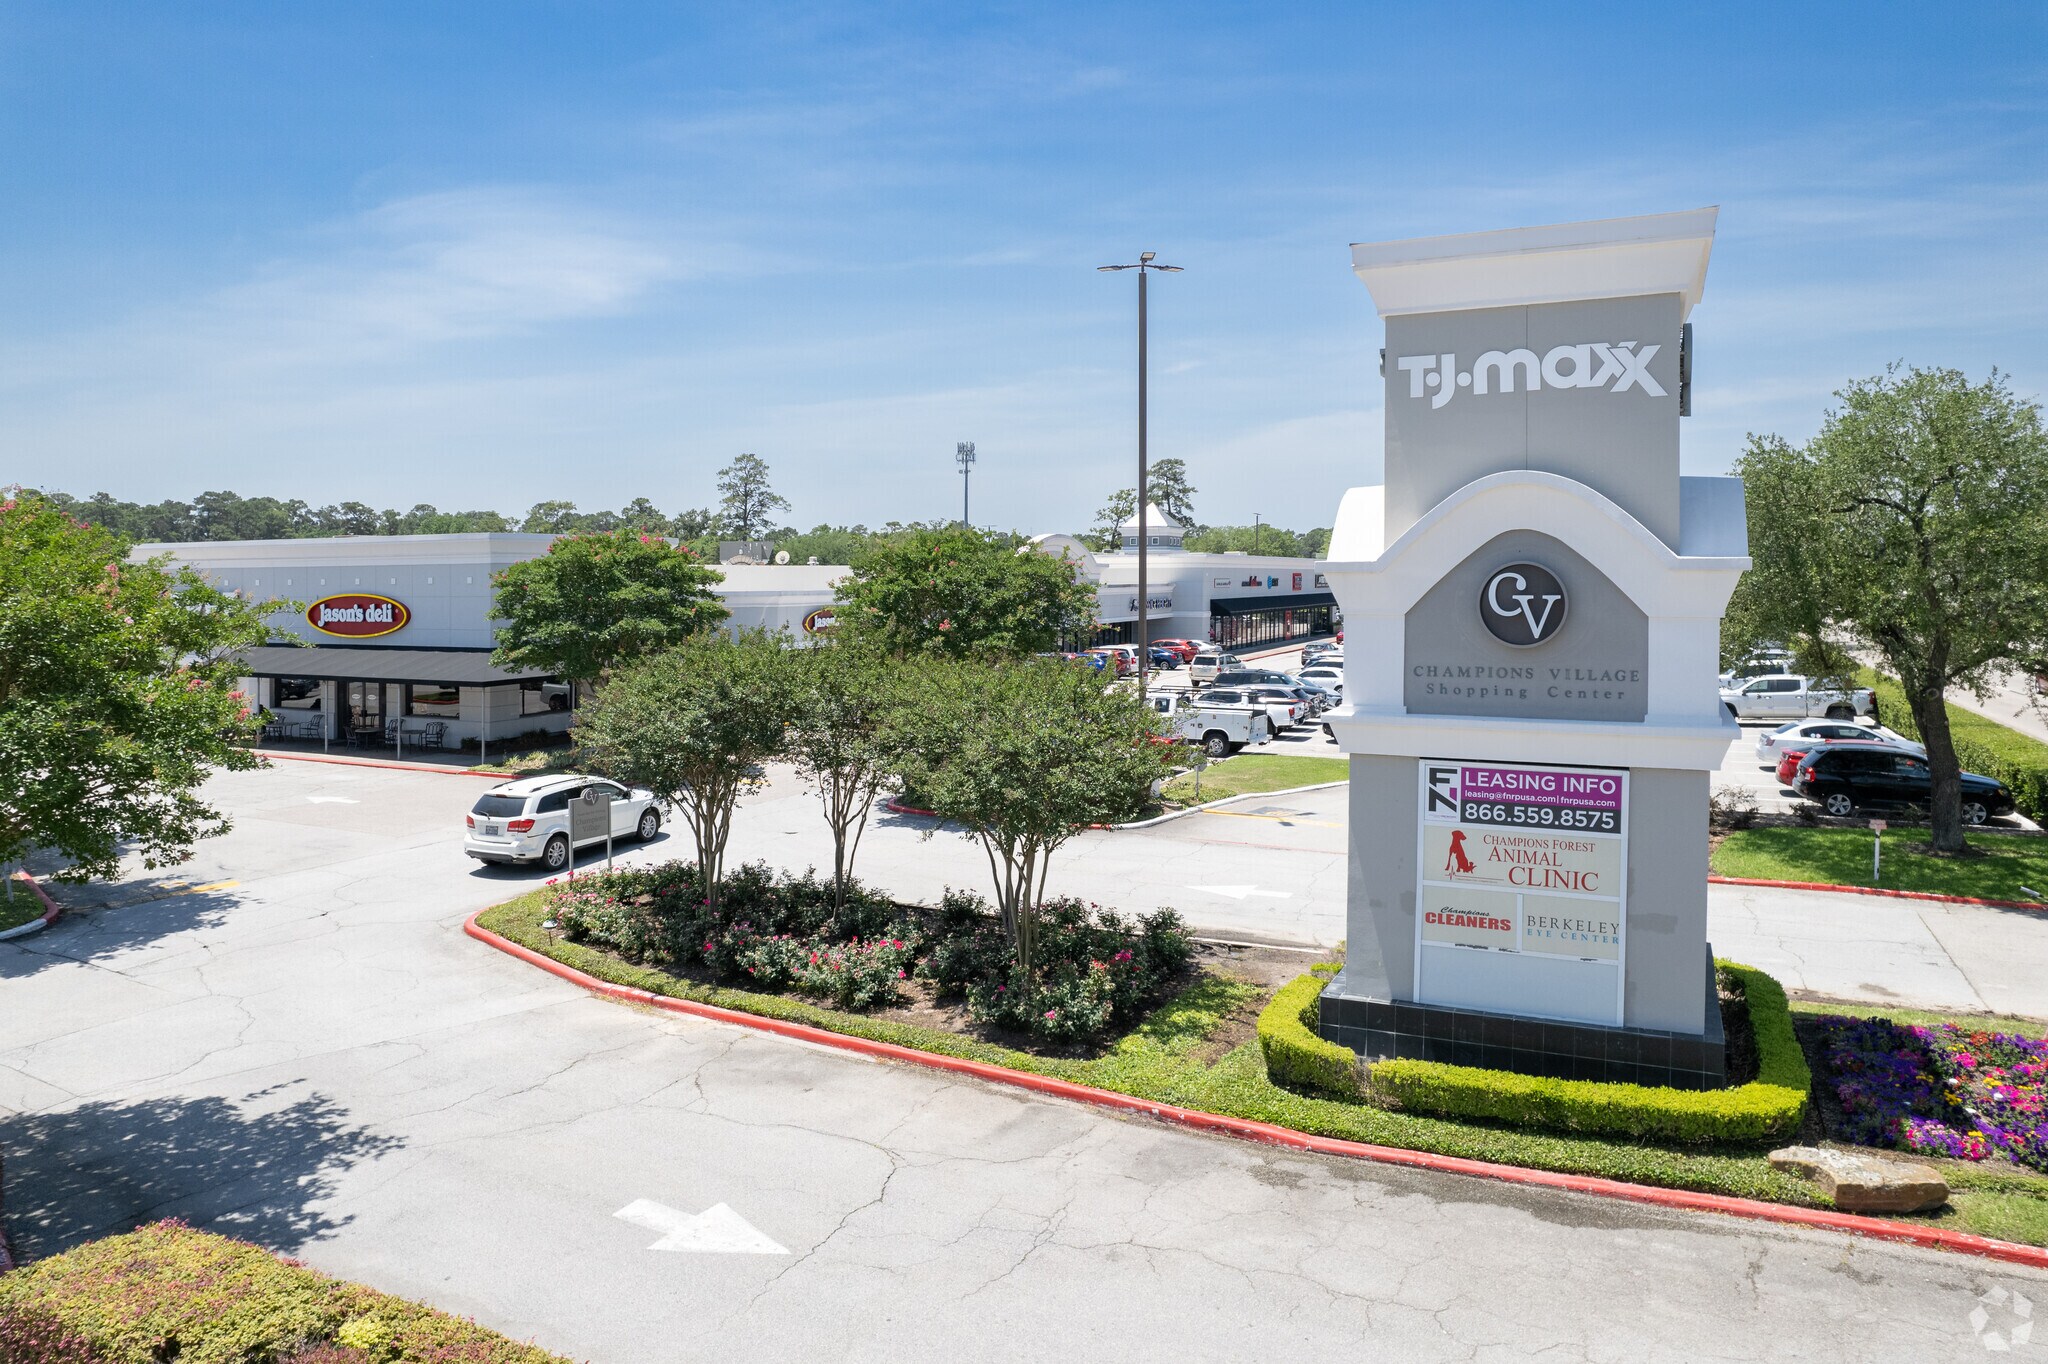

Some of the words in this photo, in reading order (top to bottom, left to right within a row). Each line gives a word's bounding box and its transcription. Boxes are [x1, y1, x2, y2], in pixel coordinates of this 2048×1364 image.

[318, 603, 363, 627] Jason's
[366, 603, 393, 622] deli
[1413, 665, 1534, 680] CHAMPIONS
[1549, 668, 1640, 683] VILLAGE
[1427, 683, 1527, 699] Shopping
[1547, 686, 1625, 700] Center
[1465, 771, 1556, 791] LEASING
[1563, 776, 1616, 795] INFO
[1465, 803, 1614, 829] 866.559.8575
[1483, 834, 1549, 849] CHAMPIONS
[1552, 839, 1596, 853] FOREST
[1488, 845, 1563, 867] ANIMAL
[1508, 866, 1599, 892] CLINIC
[1440, 906, 1490, 916] Champions
[1425, 912, 1511, 931] CLEANERS
[1527, 915, 1619, 935] BERKELEY
[1527, 928, 1551, 938] EYE
[1561, 932, 1619, 945] CENTER
